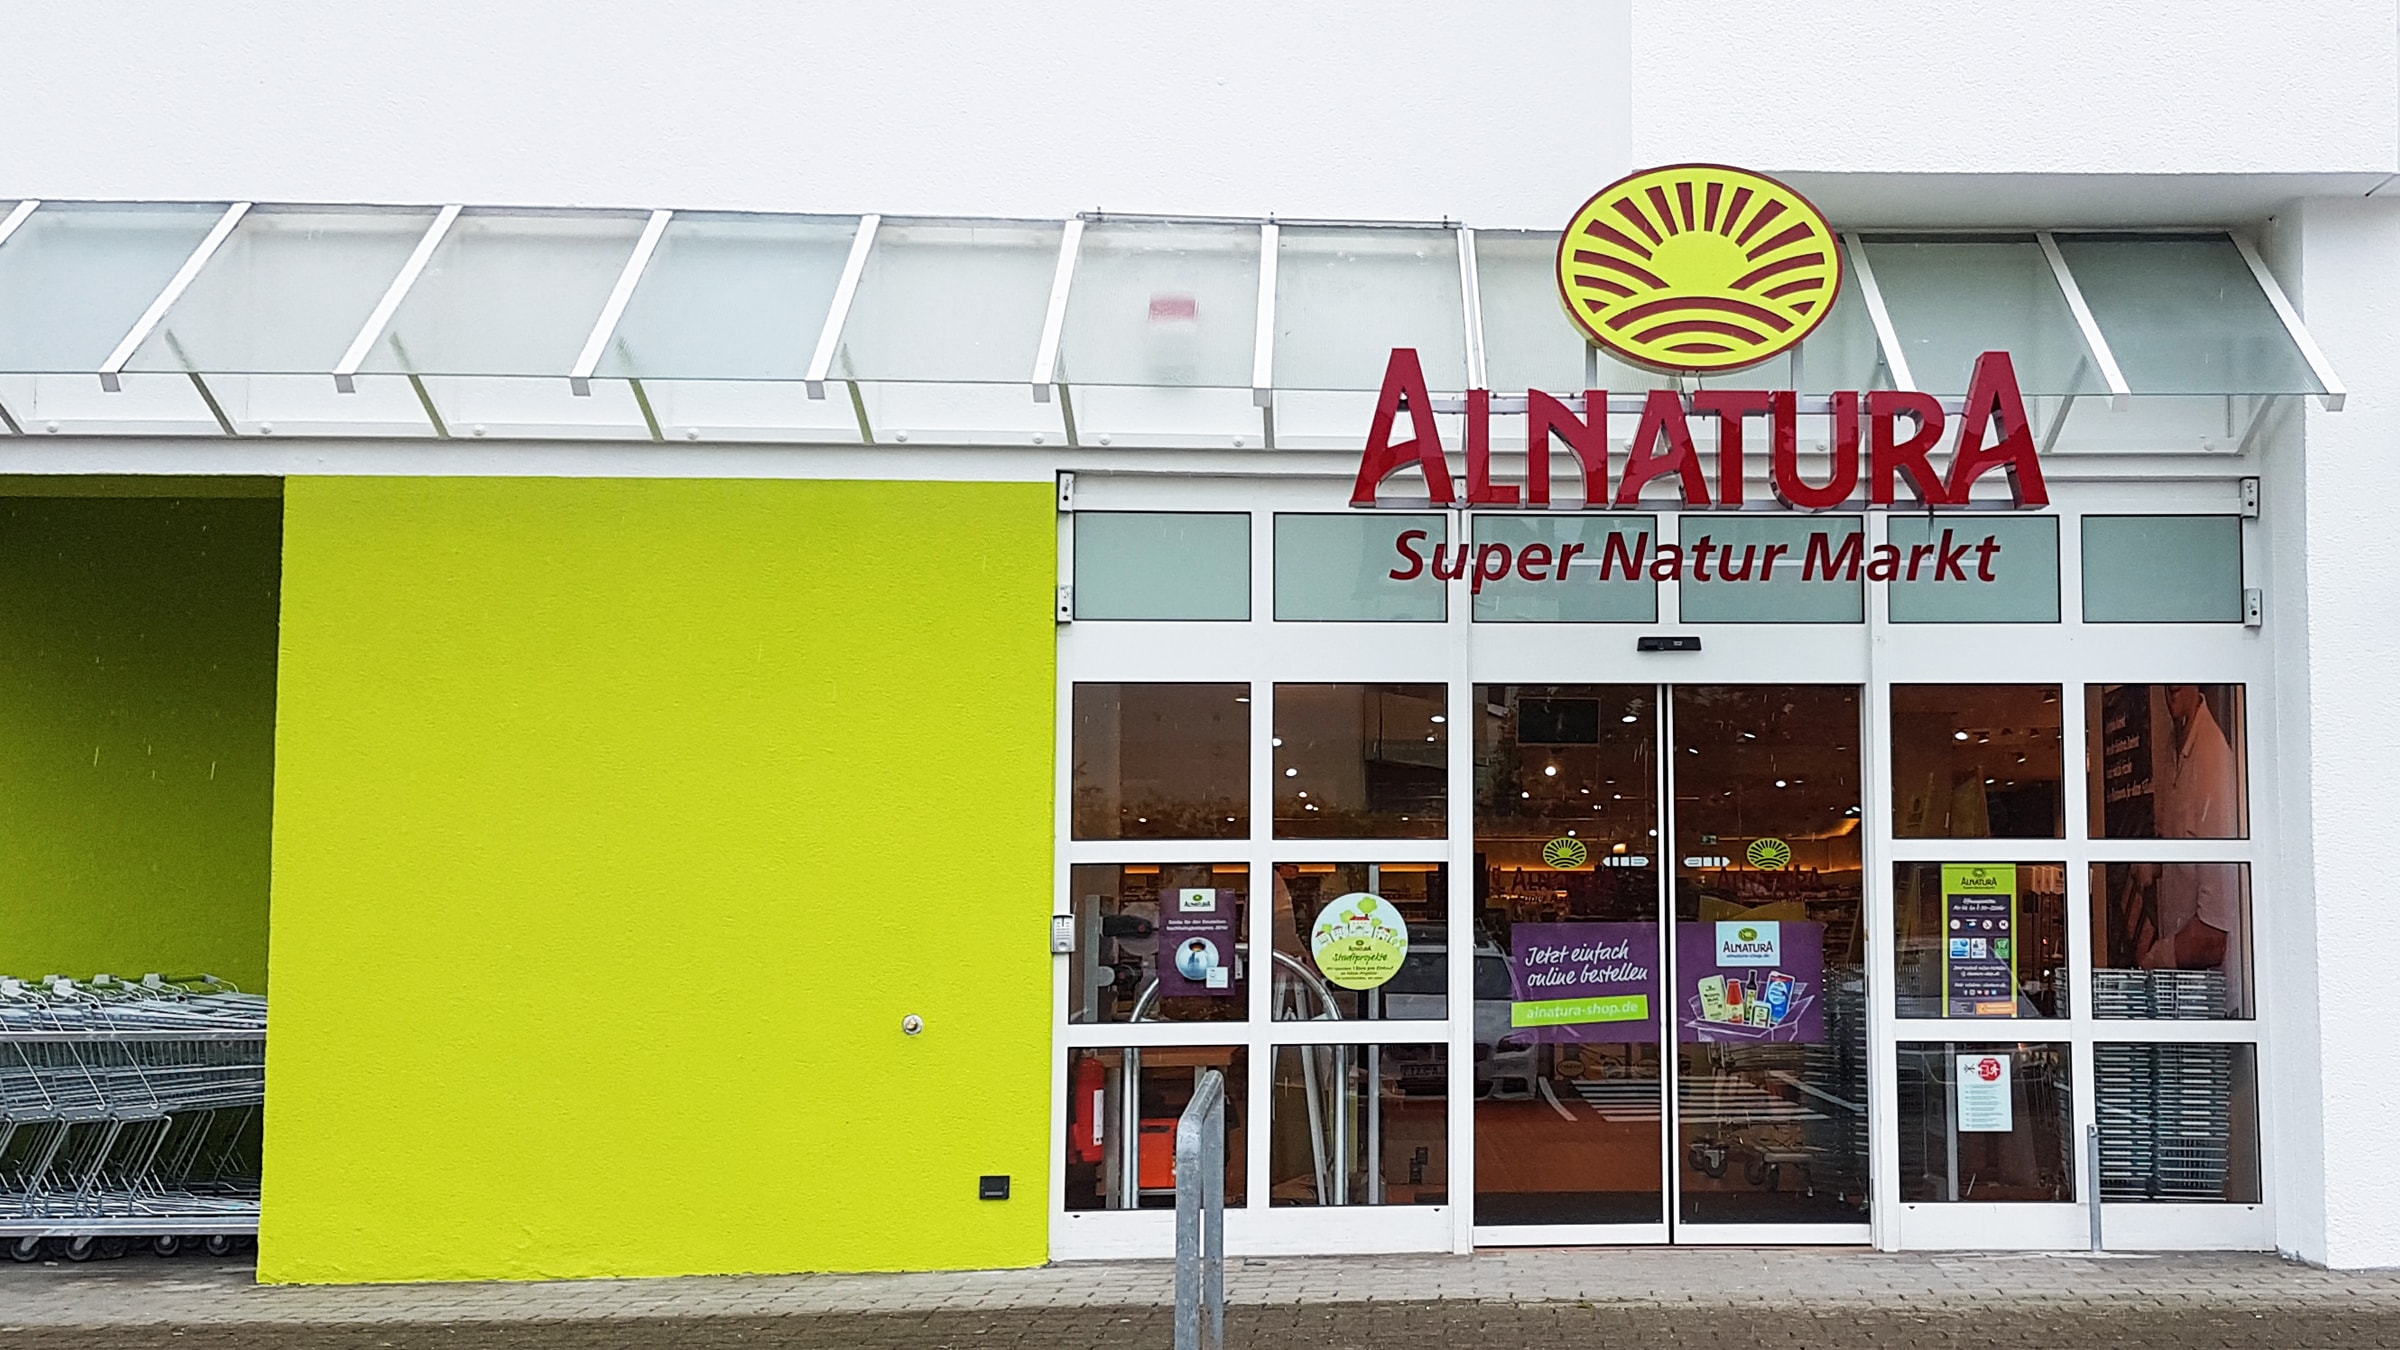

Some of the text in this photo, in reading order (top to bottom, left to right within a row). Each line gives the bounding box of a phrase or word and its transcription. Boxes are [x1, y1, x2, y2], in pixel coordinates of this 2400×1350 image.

[1351, 348, 2049, 512] ALNATURA
[1389, 528, 2000, 595] Super Natur Markt
[1961, 877, 1997, 886] ALNATURA
[1525, 938, 1629, 967] Jetzt einfach
[1723, 941, 1774, 953] ALNATURA
[1527, 962, 1649, 987] online bestellen
[1527, 1001, 1639, 1019] alnatura-shop.de
